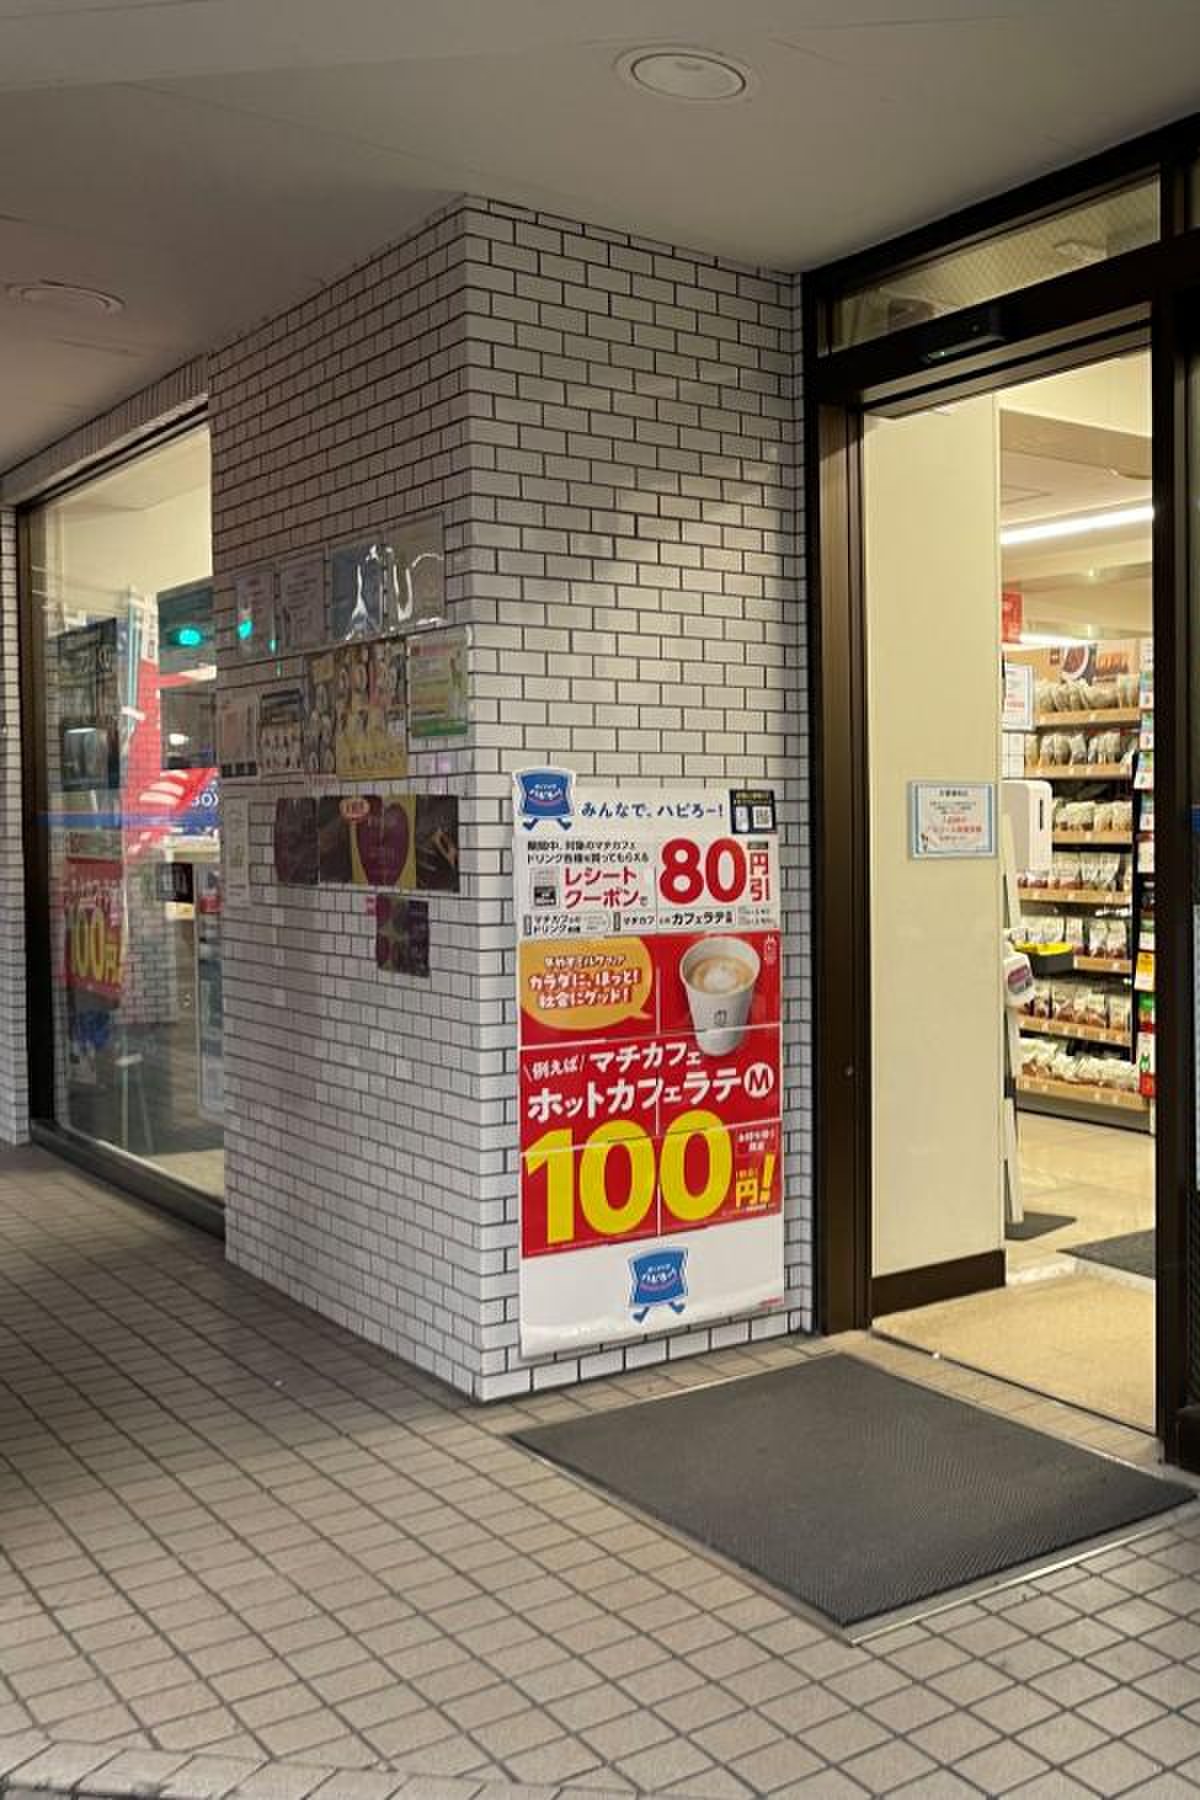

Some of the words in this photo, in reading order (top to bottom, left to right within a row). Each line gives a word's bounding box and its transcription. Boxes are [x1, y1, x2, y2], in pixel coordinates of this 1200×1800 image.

[565, 866, 638, 886] レシート
[660, 838, 746, 904] 80
[589, 1042, 702, 1073] マチカフェ
[527, 1067, 742, 1123] ホットカフェラテ
[525, 1109, 733, 1244] 100
